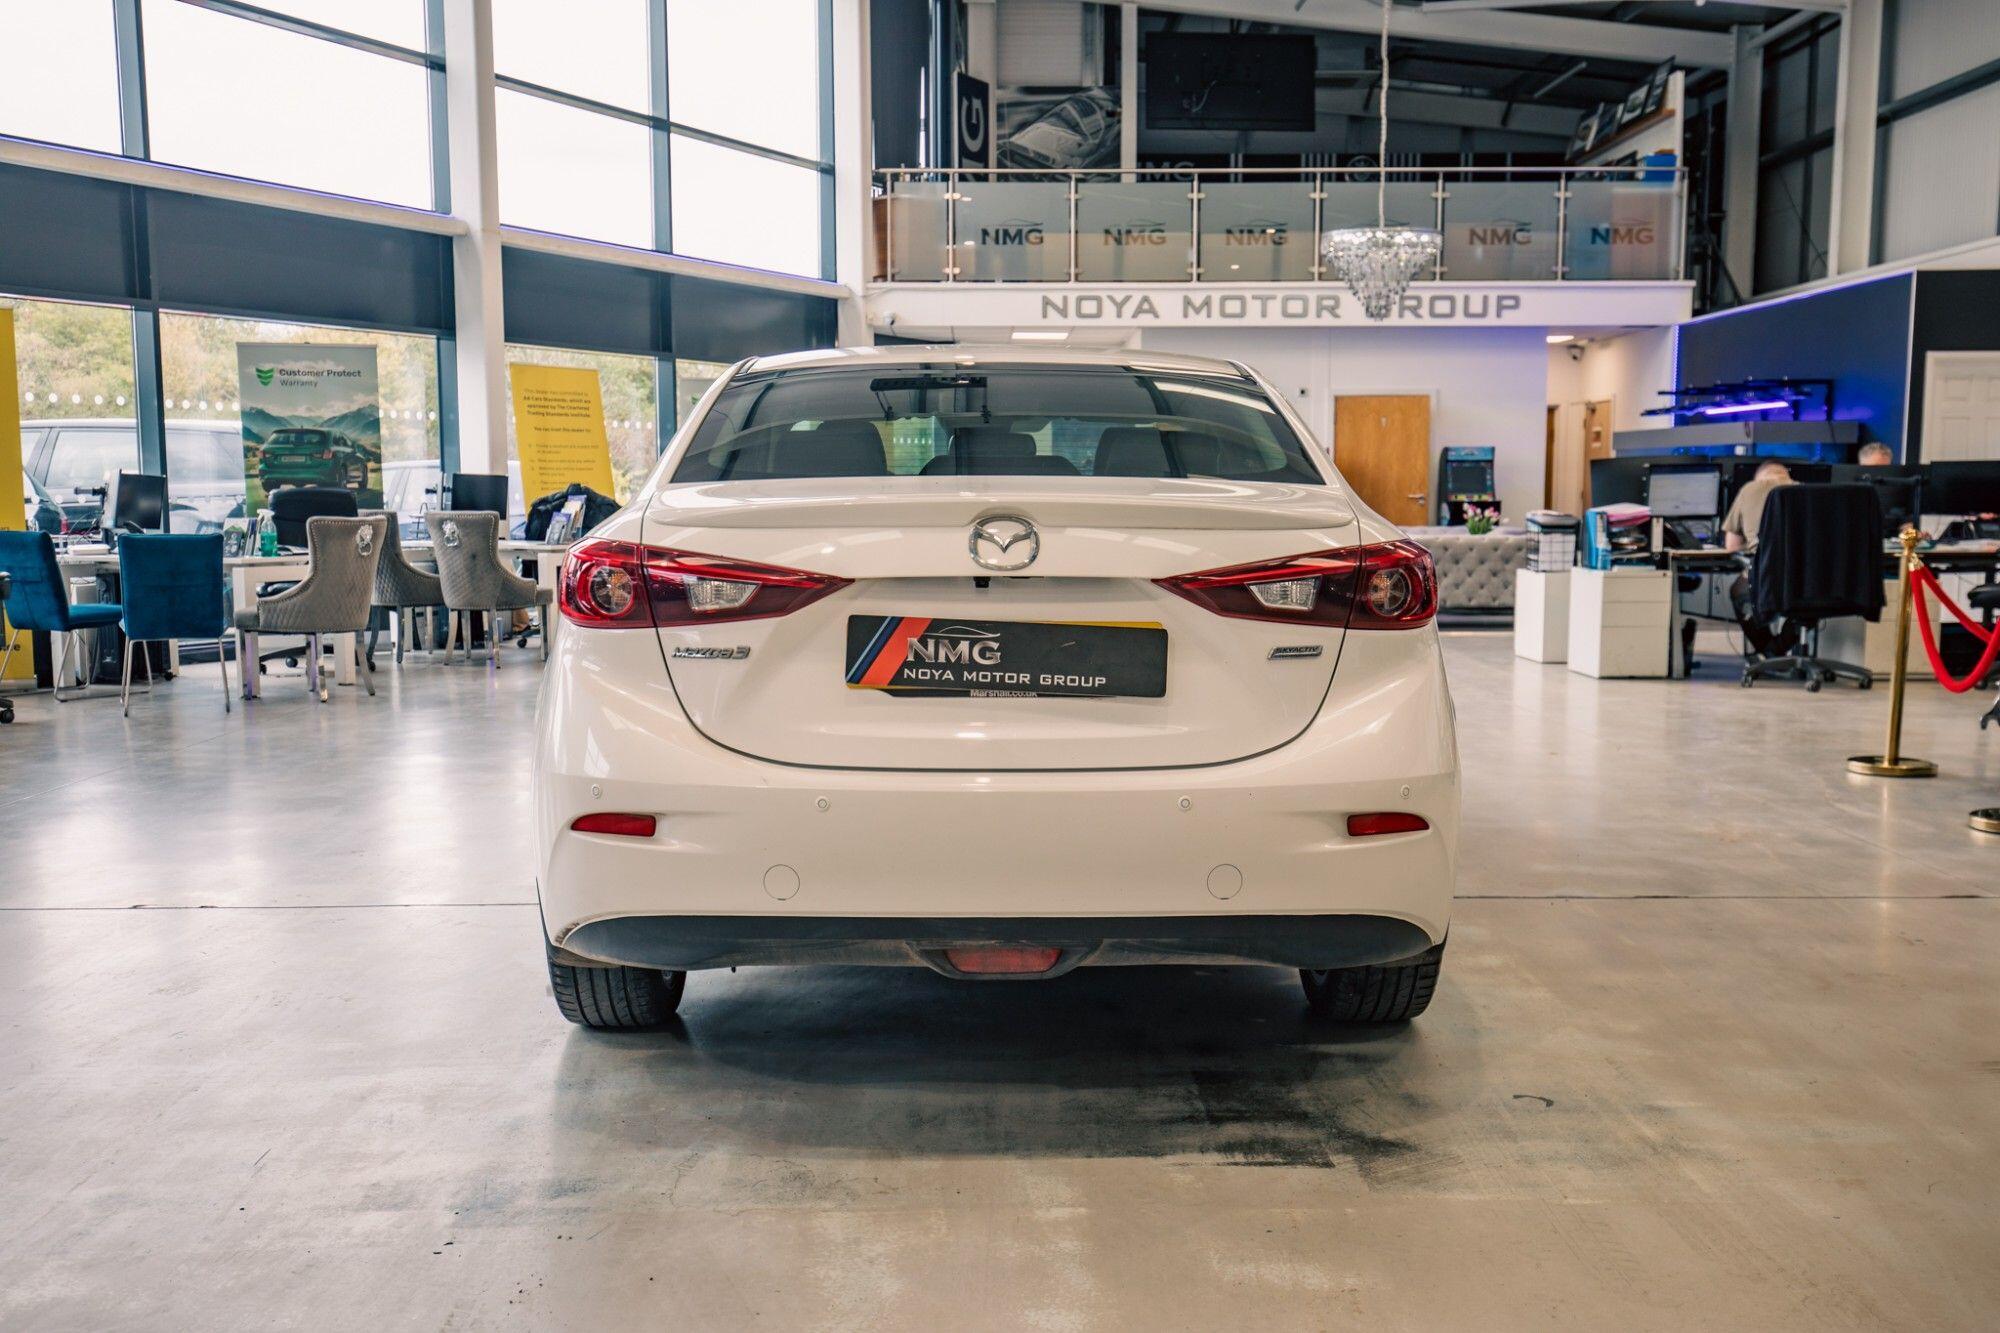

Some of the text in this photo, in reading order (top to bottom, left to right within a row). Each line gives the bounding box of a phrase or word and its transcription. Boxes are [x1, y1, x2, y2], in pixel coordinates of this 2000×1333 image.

[981, 228, 1044, 246] NMG
[1103, 228, 1166, 246] NMG
[1225, 228, 1289, 246] NMG
[1469, 228, 1532, 246] NMG
[1590, 228, 1655, 246] NMG
[1042, 295, 1159, 319] NOYA
[1183, 294, 1341, 319] MOTOR
[279, 369, 362, 378] Customer Protect
[279, 380, 318, 388] Warranty
[906, 637, 1001, 665] NMG
[903, 668, 1106, 688] NOYA MOTOR GROUP
